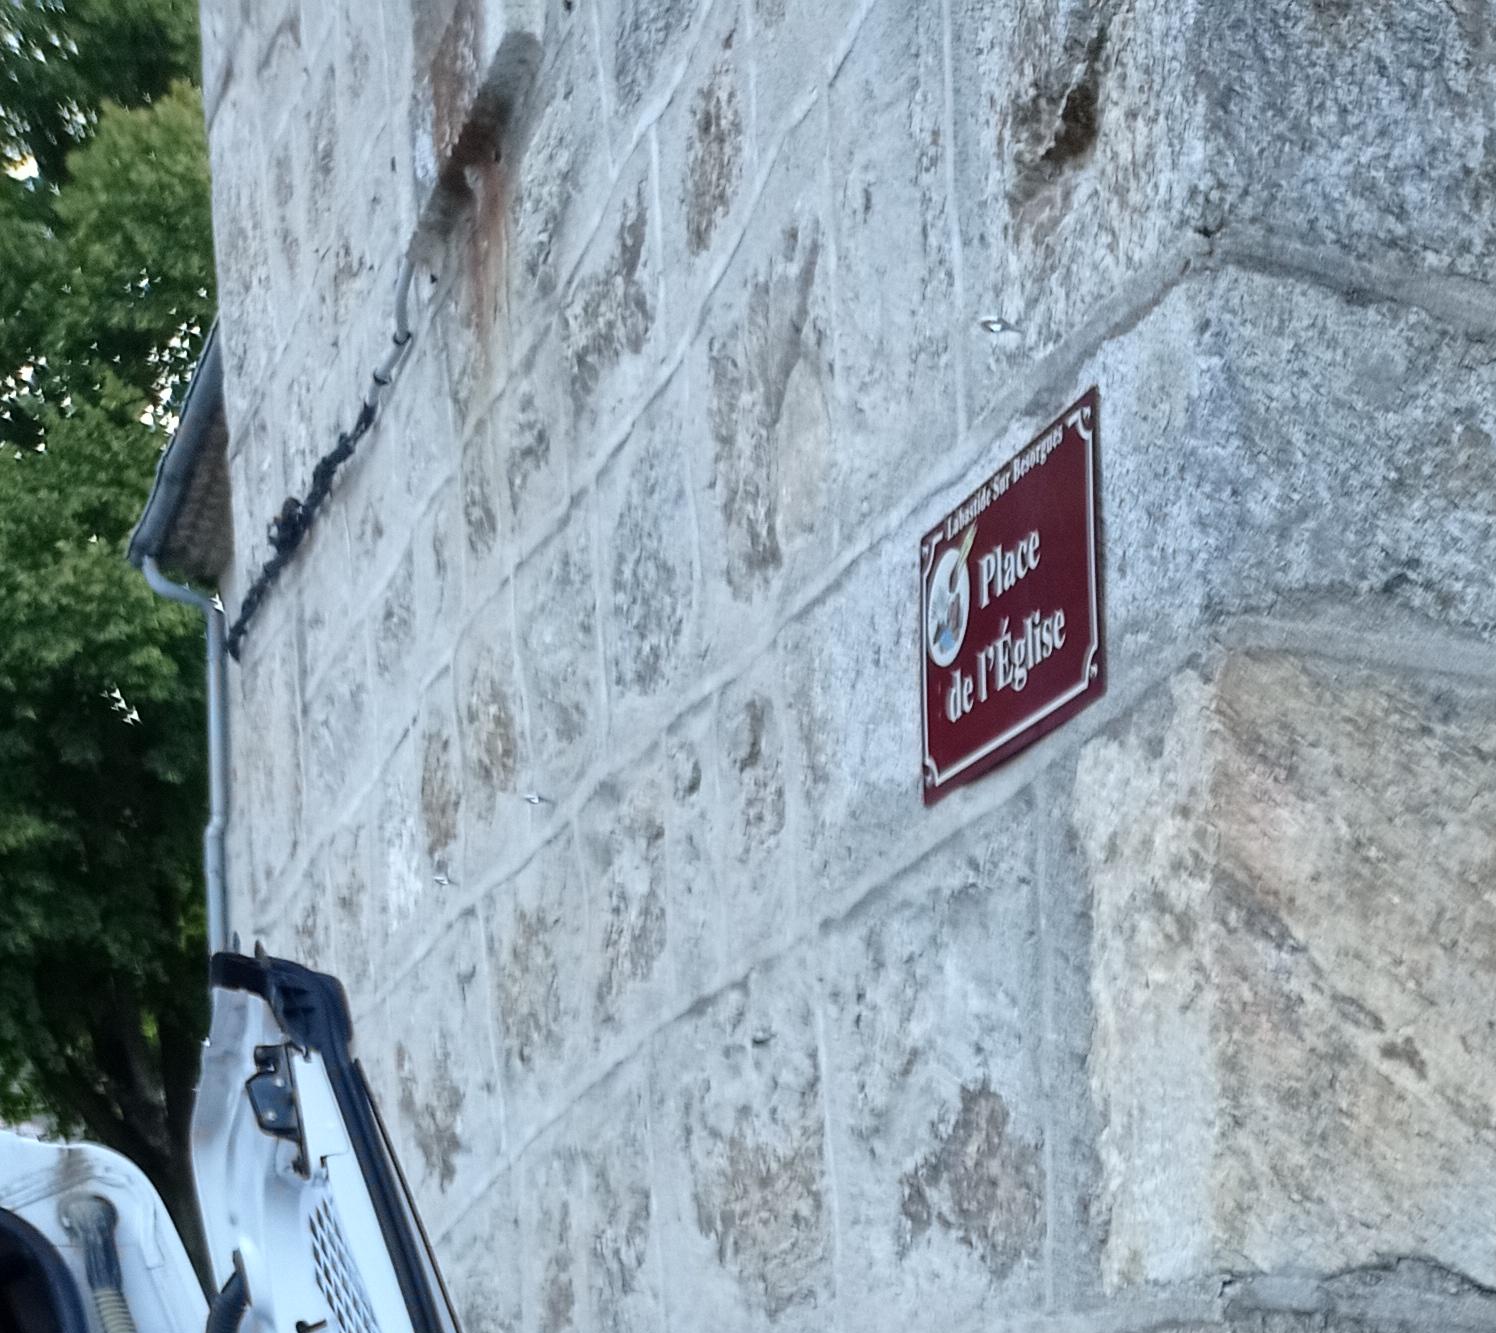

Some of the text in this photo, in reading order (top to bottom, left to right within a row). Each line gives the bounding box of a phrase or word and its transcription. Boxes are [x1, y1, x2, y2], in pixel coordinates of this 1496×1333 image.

[991, 471, 1011, 501] Sur
[978, 529, 1041, 609] Place
[946, 608, 1066, 723] de l'Église
